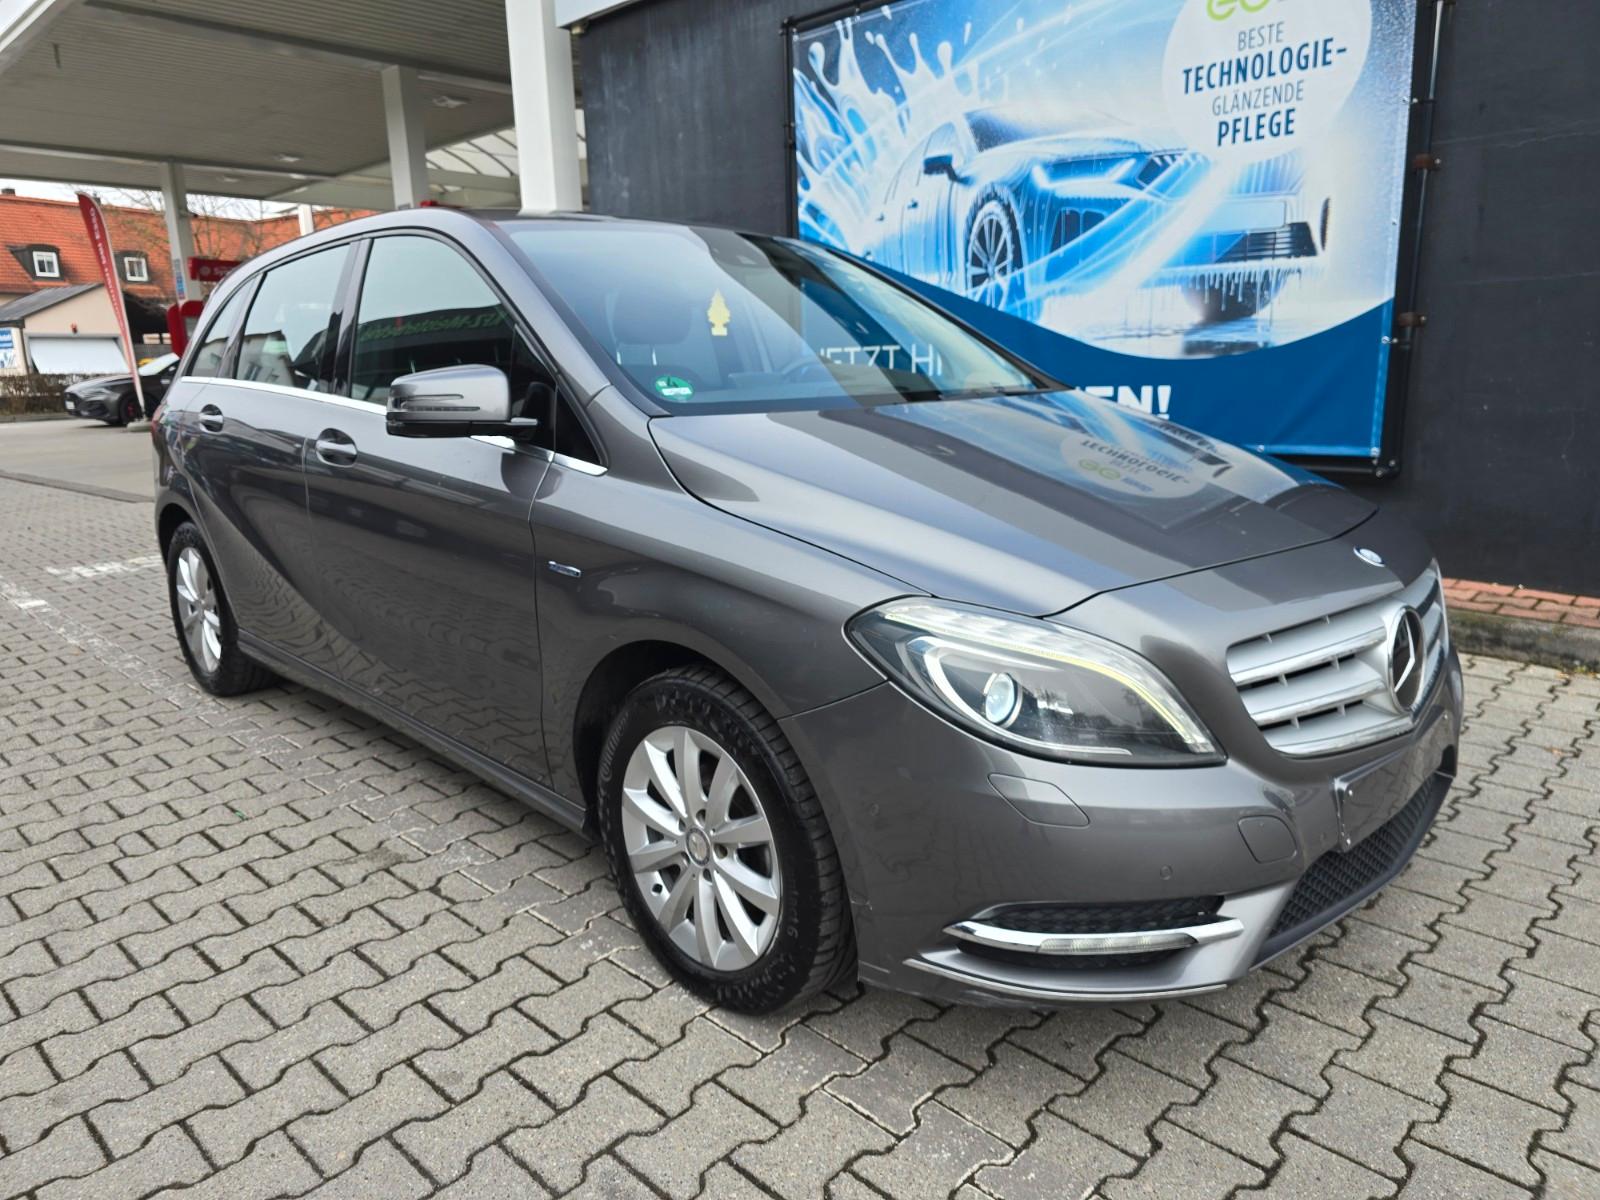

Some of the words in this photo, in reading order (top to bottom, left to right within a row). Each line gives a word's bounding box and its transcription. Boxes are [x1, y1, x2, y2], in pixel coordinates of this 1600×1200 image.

[1237, 21, 1285, 51] BESTE
[1183, 37, 1348, 94] TECHNOLOGIE-
[1212, 79, 1305, 116] GLÄNZENDE
[1217, 108, 1296, 146] PFLEGE
